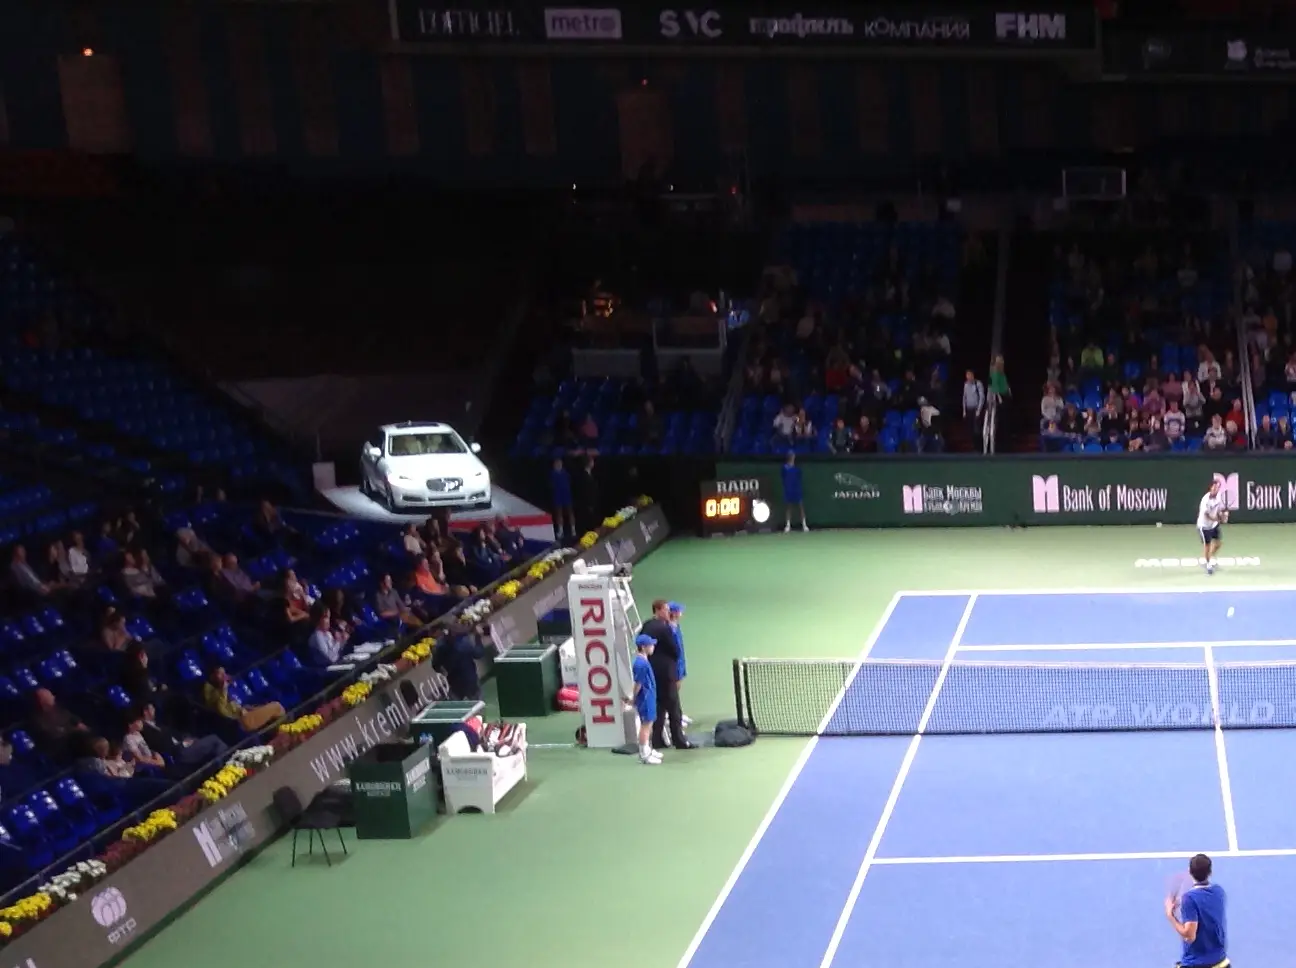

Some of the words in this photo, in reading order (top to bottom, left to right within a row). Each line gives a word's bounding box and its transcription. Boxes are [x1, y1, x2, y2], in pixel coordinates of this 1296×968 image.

[994, 13, 1066, 39] FHM
[716, 480, 760, 494] RADO
[1062, 485, 1094, 512] Bank
[1098, 485, 1111, 512] of
[1115, 485, 1168, 512] Moscow
[1245, 481, 1282, 511] Банк
[705, 497, 740, 518] 0:00
[579, 597, 616, 725] RICOH
[1043, 705, 1117, 724] ATP
[1128, 700, 1275, 724] WORLD
